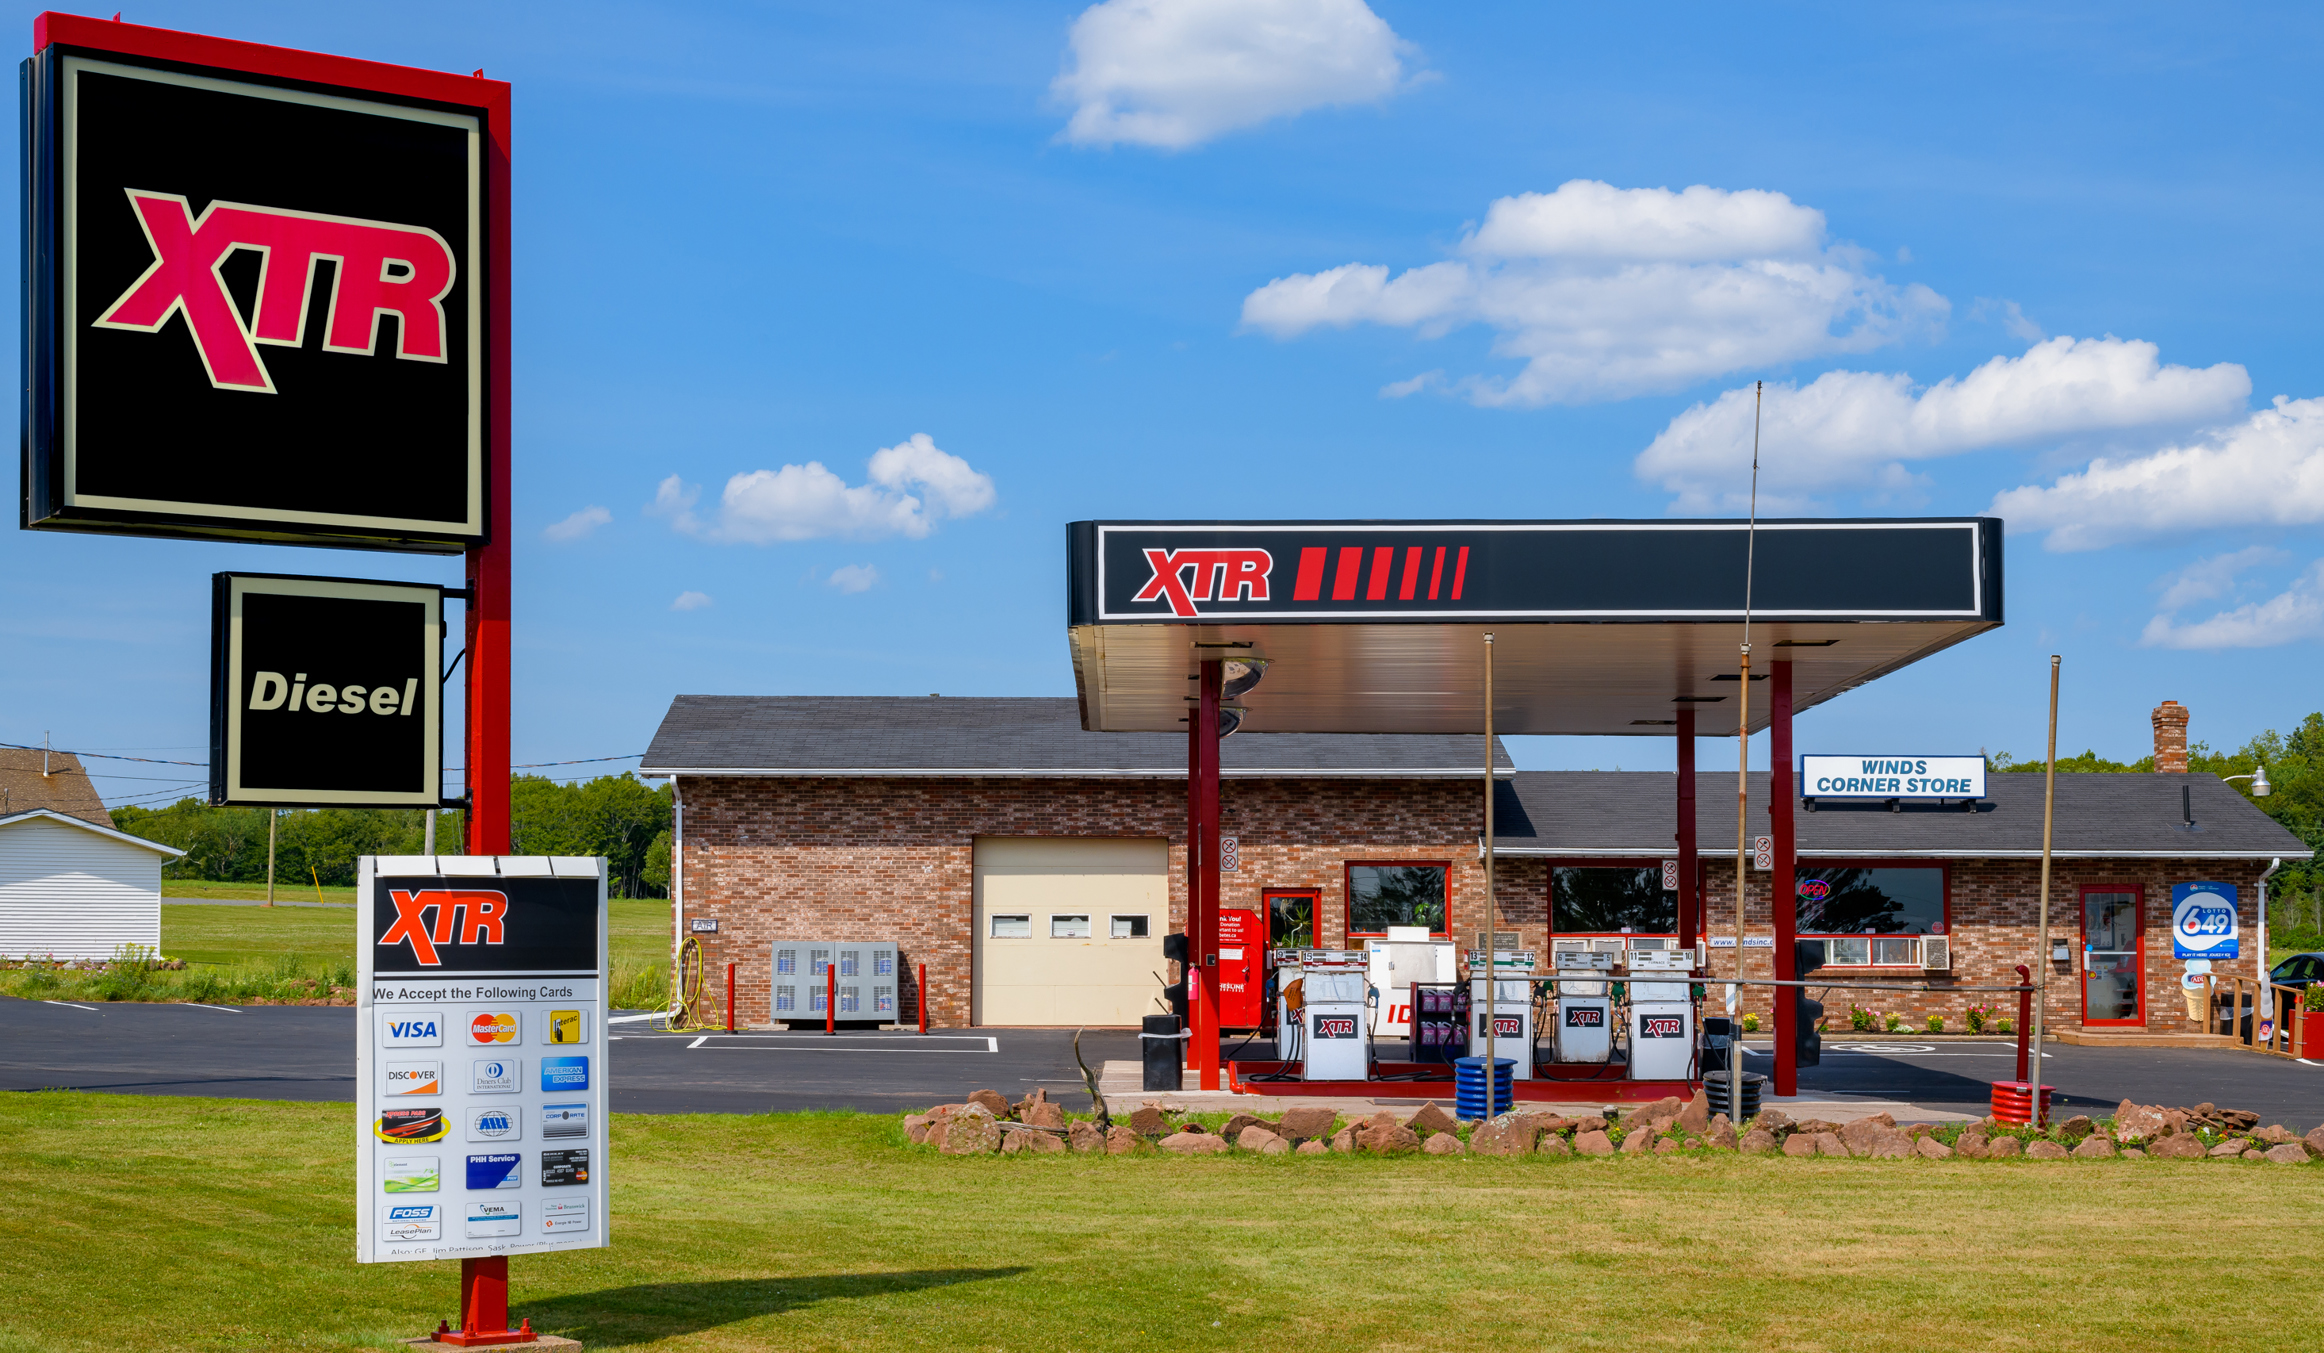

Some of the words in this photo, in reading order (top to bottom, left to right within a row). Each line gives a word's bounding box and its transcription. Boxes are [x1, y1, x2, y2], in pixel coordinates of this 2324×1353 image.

[91, 188, 456, 394] XTR
[1131, 548, 1273, 618] XTR
[249, 671, 418, 716] Diesel
[1862, 760, 1927, 775] WINDS
[1817, 777, 1900, 792] CORNER
[1906, 778, 1971, 793] STORE
[1800, 885, 1827, 896] OPEN
[377, 889, 508, 966] XTR
[696, 921, 713, 930] AIR
[1359, 953, 1367, 961] 14
[1470, 952, 1478, 960] 13
[1526, 953, 1534, 961] 12
[1558, 953, 1562, 961] 6
[1630, 952, 1637, 960] 11
[1685, 952, 1692, 960] 10
[372, 988, 393, 1000] We
[398, 987, 447, 1001] Accept
[451, 987, 472, 999] the
[476, 986, 536, 1000] Following
[540, 986, 573, 998] Cards
[1387, 1004, 1411, 1023] IC
[1570, 1010, 1600, 1026] XTR
[387, 1022, 437, 1037] VISA
[472, 1024, 515, 1033] MasterCard
[553, 1016, 577, 1032] Interac
[1318, 1019, 1354, 1038] XTR
[1645, 1019, 1680, 1037] XTR
[388, 1071, 435, 1079] DISCOVER
[544, 1066, 583, 1075] AMERICAN
[477, 1077, 496, 1085] Diners
[553, 1075, 585, 1083] EXPRESS
[479, 1117, 508, 1130] ARI
[393, 1209, 430, 1217] FOSS
